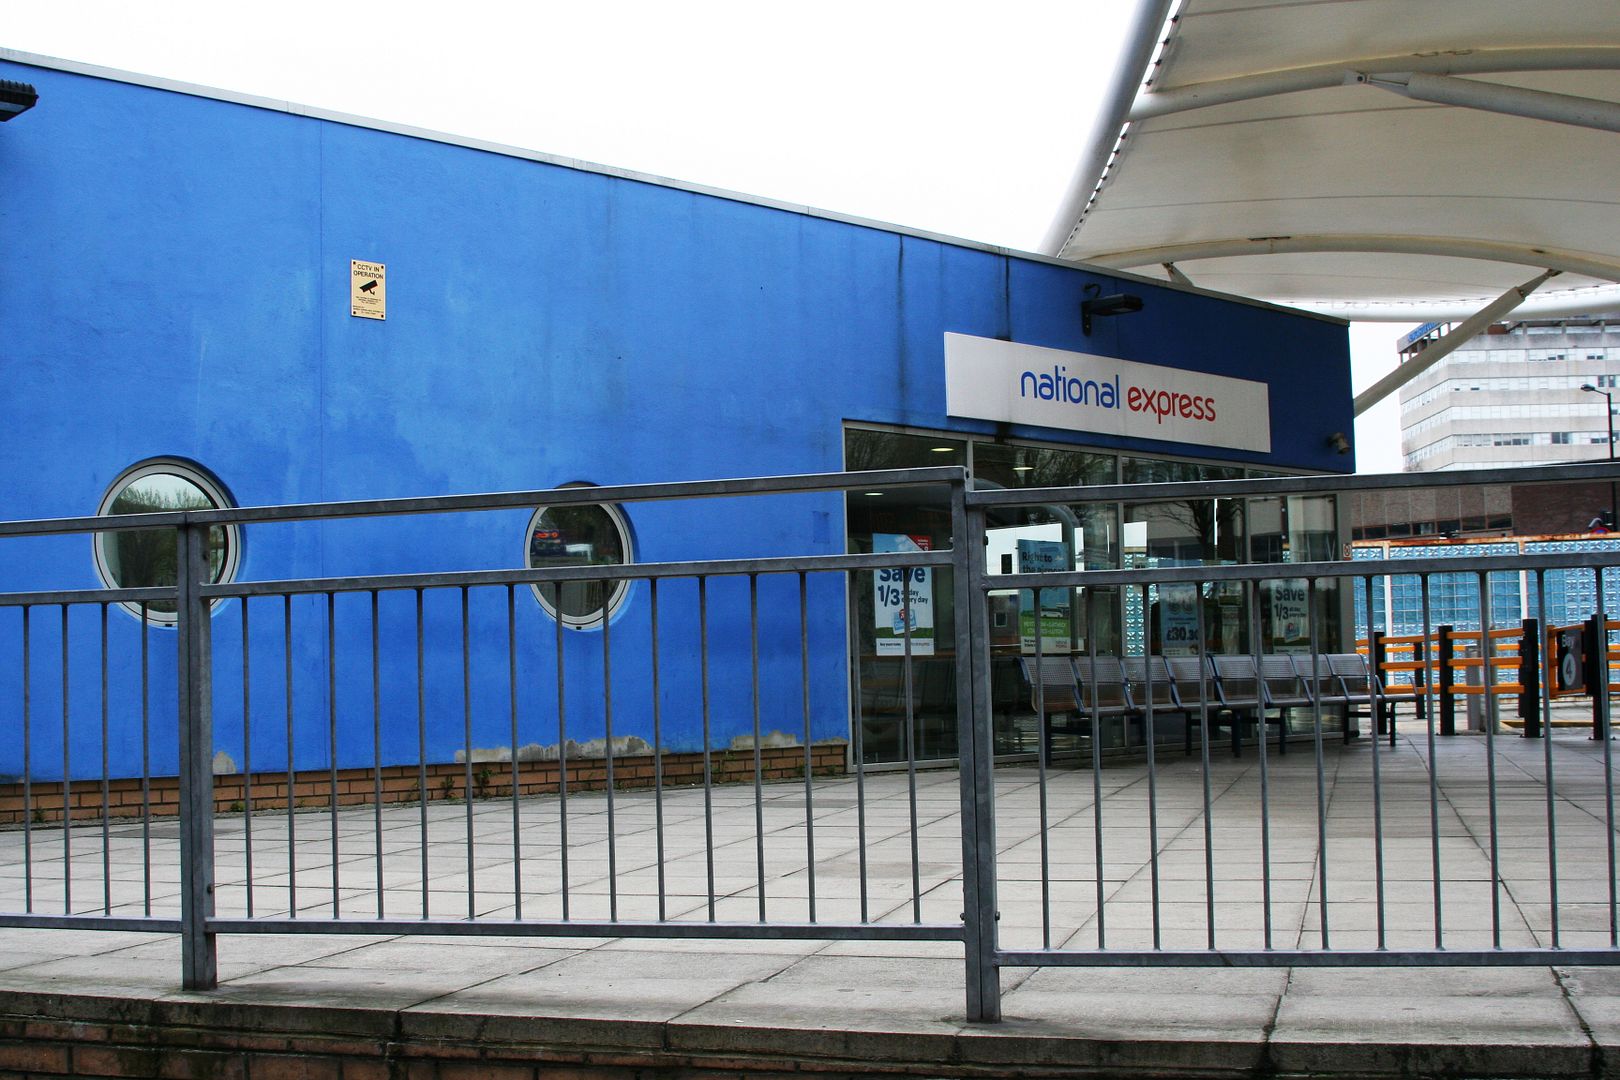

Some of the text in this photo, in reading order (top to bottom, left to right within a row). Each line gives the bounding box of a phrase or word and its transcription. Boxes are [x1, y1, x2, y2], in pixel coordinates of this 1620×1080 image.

[353, 270, 384, 279] OPERATION
[1020, 365, 1217, 425] national express
[877, 584, 901, 607] 1/3
[1275, 585, 1305, 602] Save
